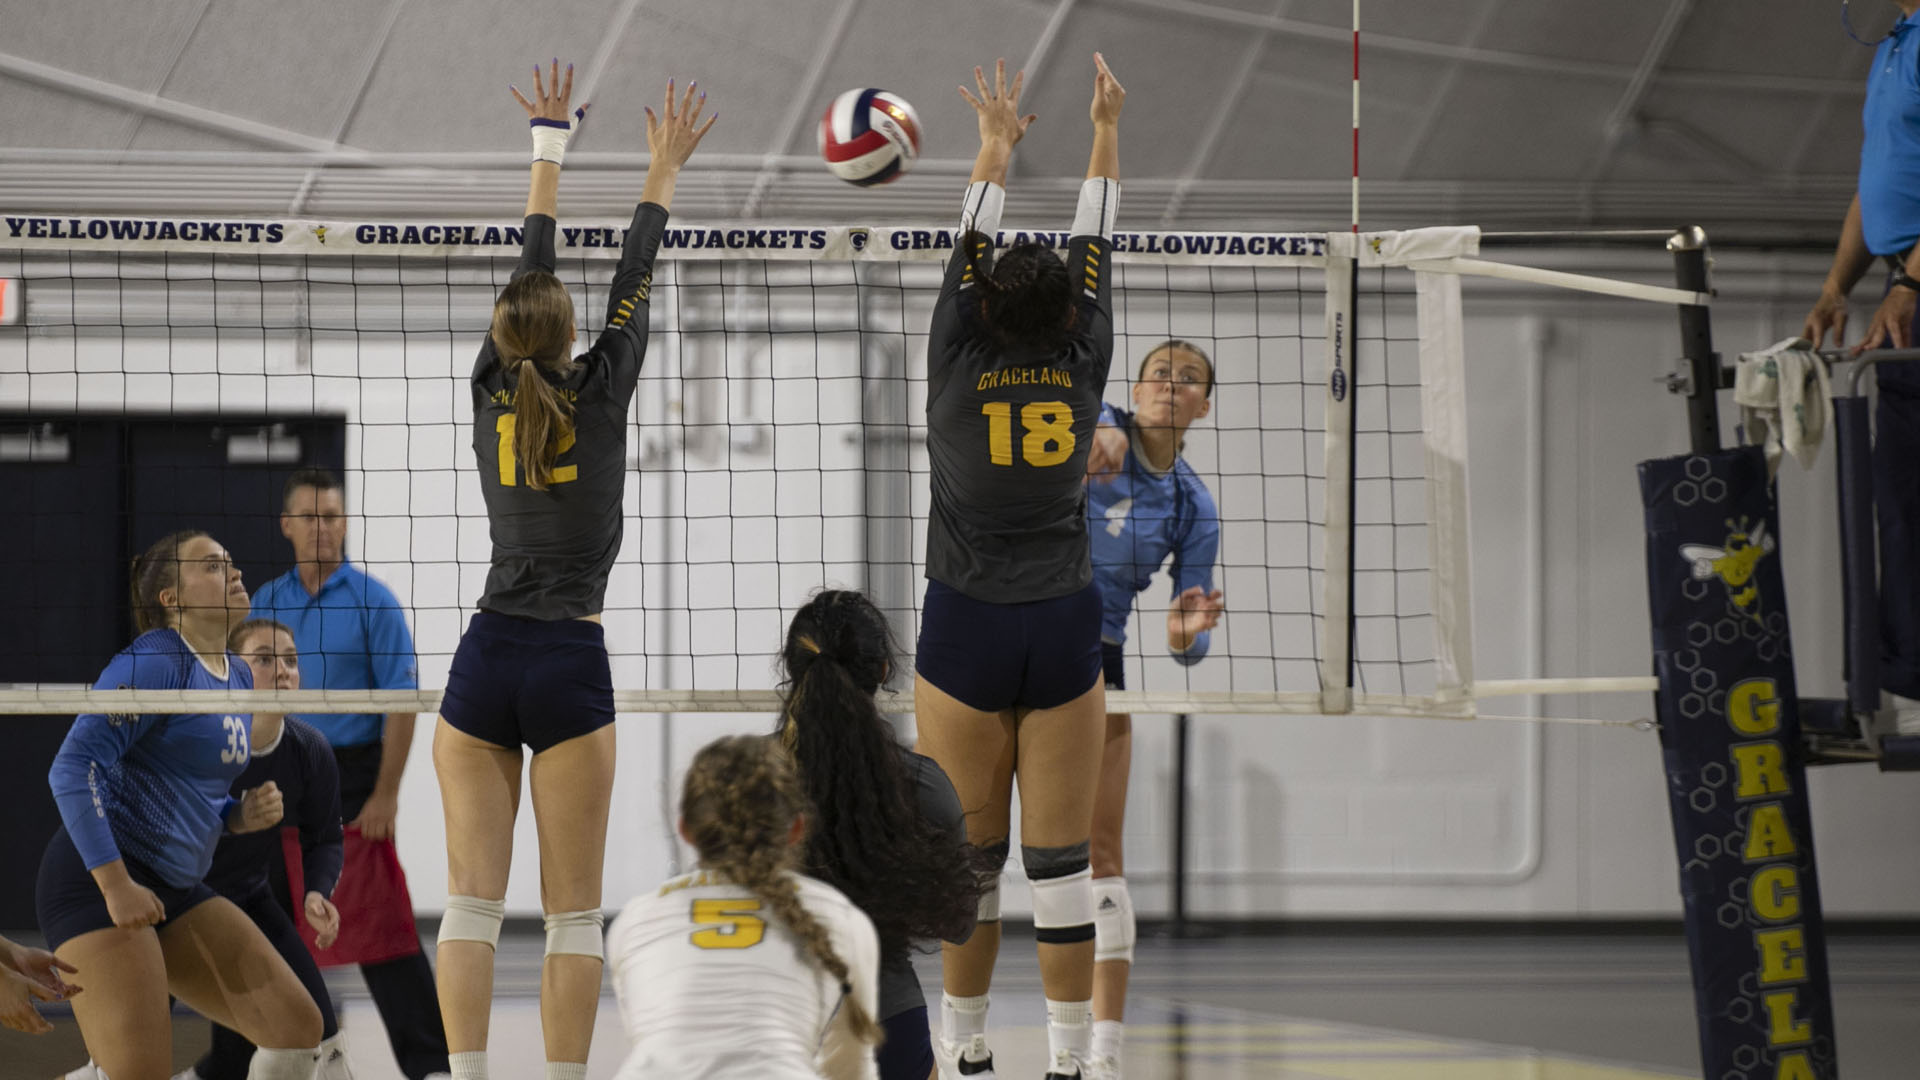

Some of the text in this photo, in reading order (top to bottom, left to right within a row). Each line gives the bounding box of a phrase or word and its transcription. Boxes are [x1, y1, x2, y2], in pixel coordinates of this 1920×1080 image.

[6, 217, 827, 250] YELLOWJACKETS GRACELAN YELWJACKETS
[890, 230, 1326, 257] GRALAN ELLOWJACKET
[976, 367, 1073, 392] GRACELAND
[981, 400, 1076, 468] 18
[220, 715, 249, 765] 33
[690, 898, 767, 950] 5
